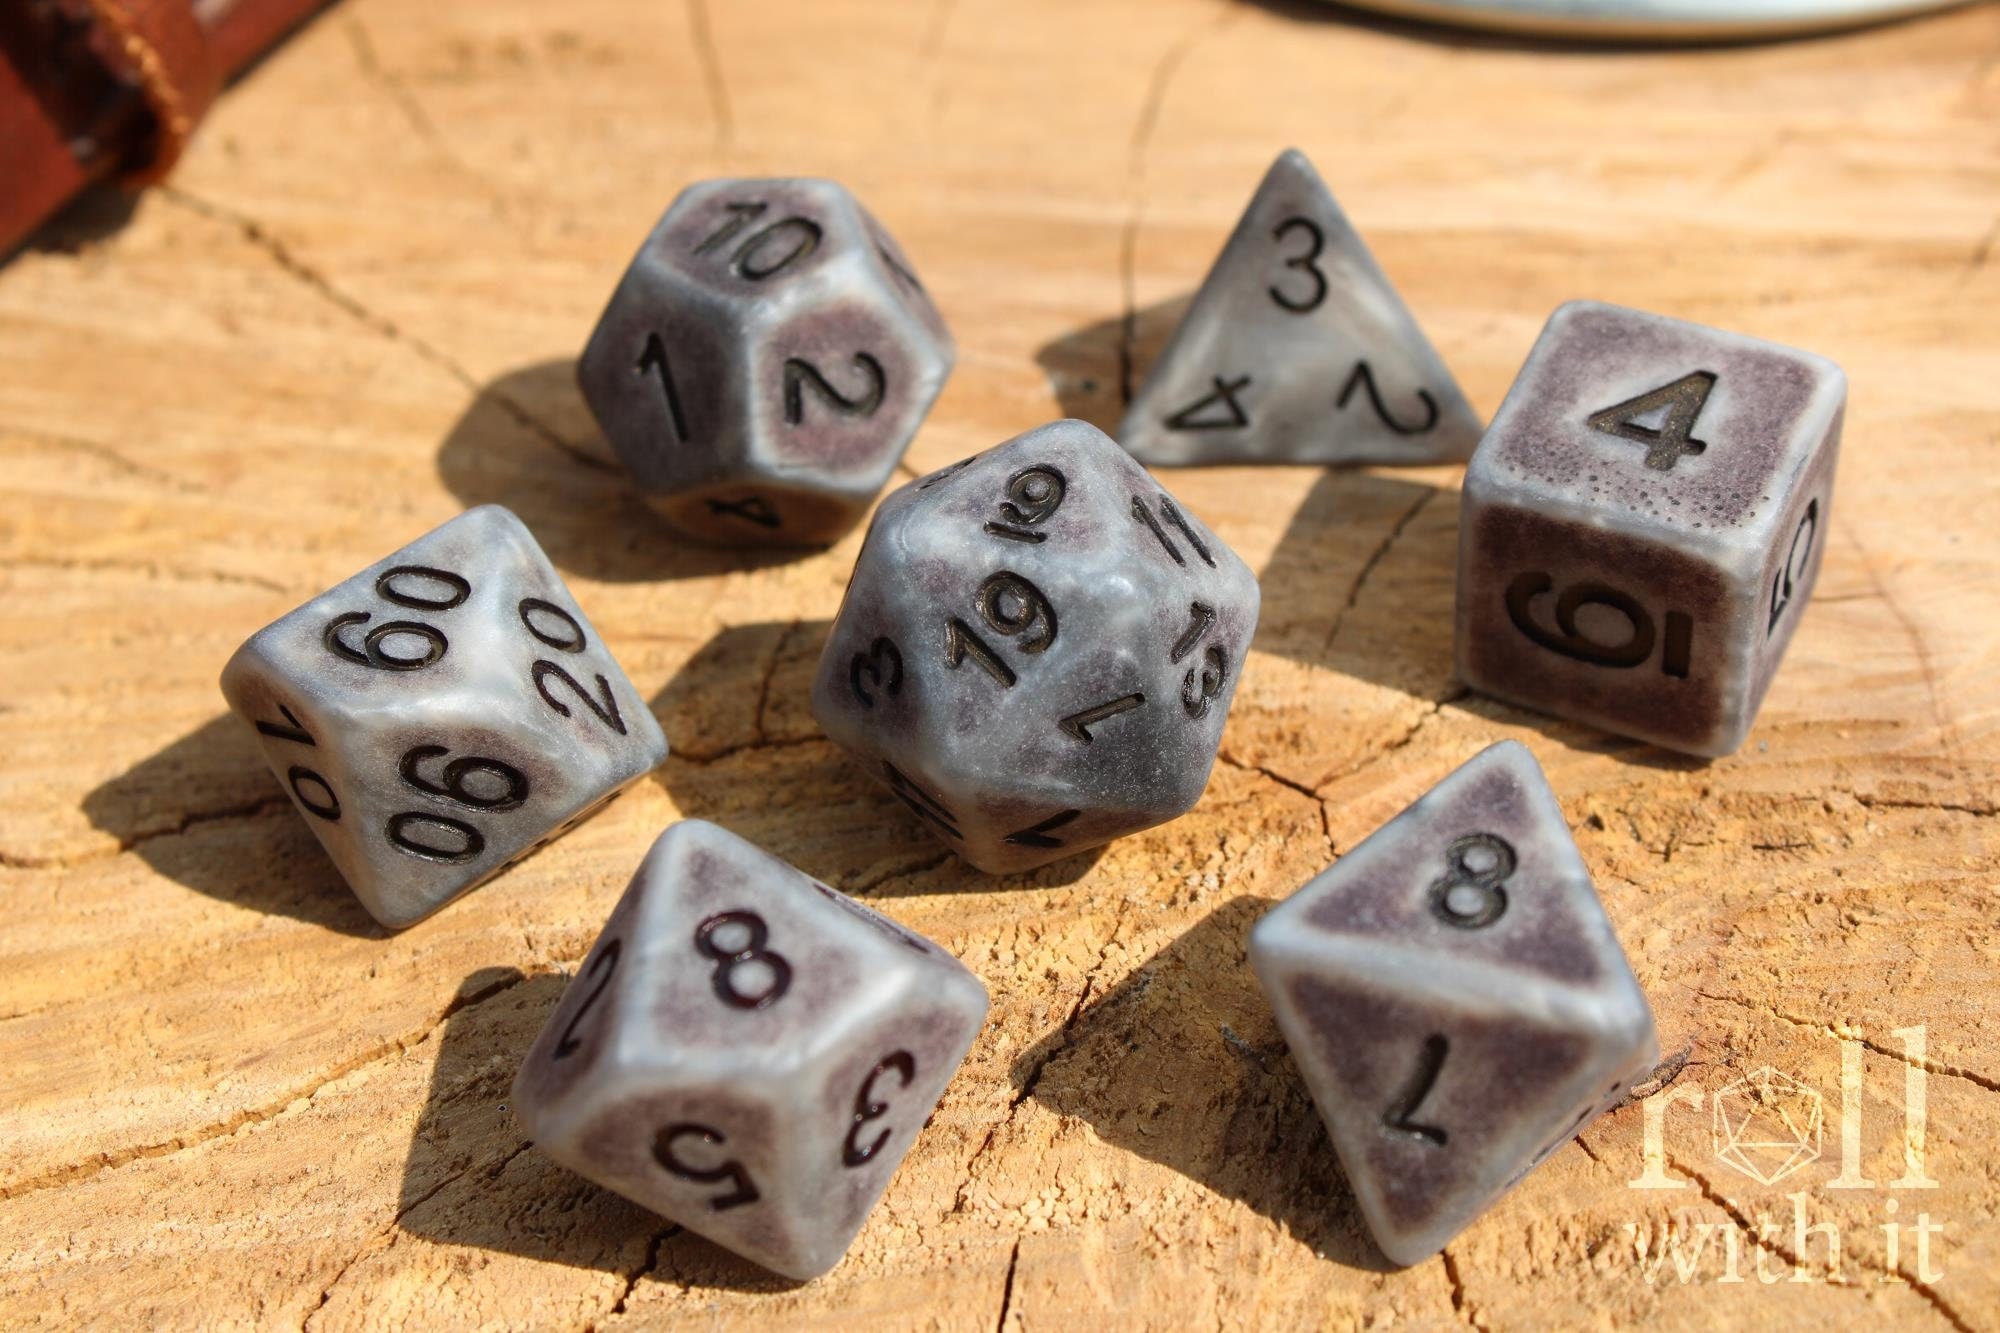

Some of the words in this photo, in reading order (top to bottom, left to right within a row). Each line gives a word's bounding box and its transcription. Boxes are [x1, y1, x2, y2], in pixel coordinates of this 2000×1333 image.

[691, 202, 822, 281] 10
[1269, 216, 1328, 315] 3
[637, 331, 689, 442] 1
[784, 350, 887, 426] 2
[1162, 374, 1254, 433] 4
[1335, 359, 1439, 436] 2
[1586, 369, 1718, 471] 4
[1132, 493, 1217, 568] 11
[323, 565, 471, 671] 60
[518, 598, 627, 735] 20
[944, 570, 1058, 688] 19
[850, 636, 904, 708] 3
[384, 745, 529, 864] 90
[1428, 832, 1519, 930] 8
[554, 938, 621, 1060] 2
[694, 909, 793, 1011] 8
[842, 1050, 915, 1168] 3
[652, 1122, 760, 1212] 5
